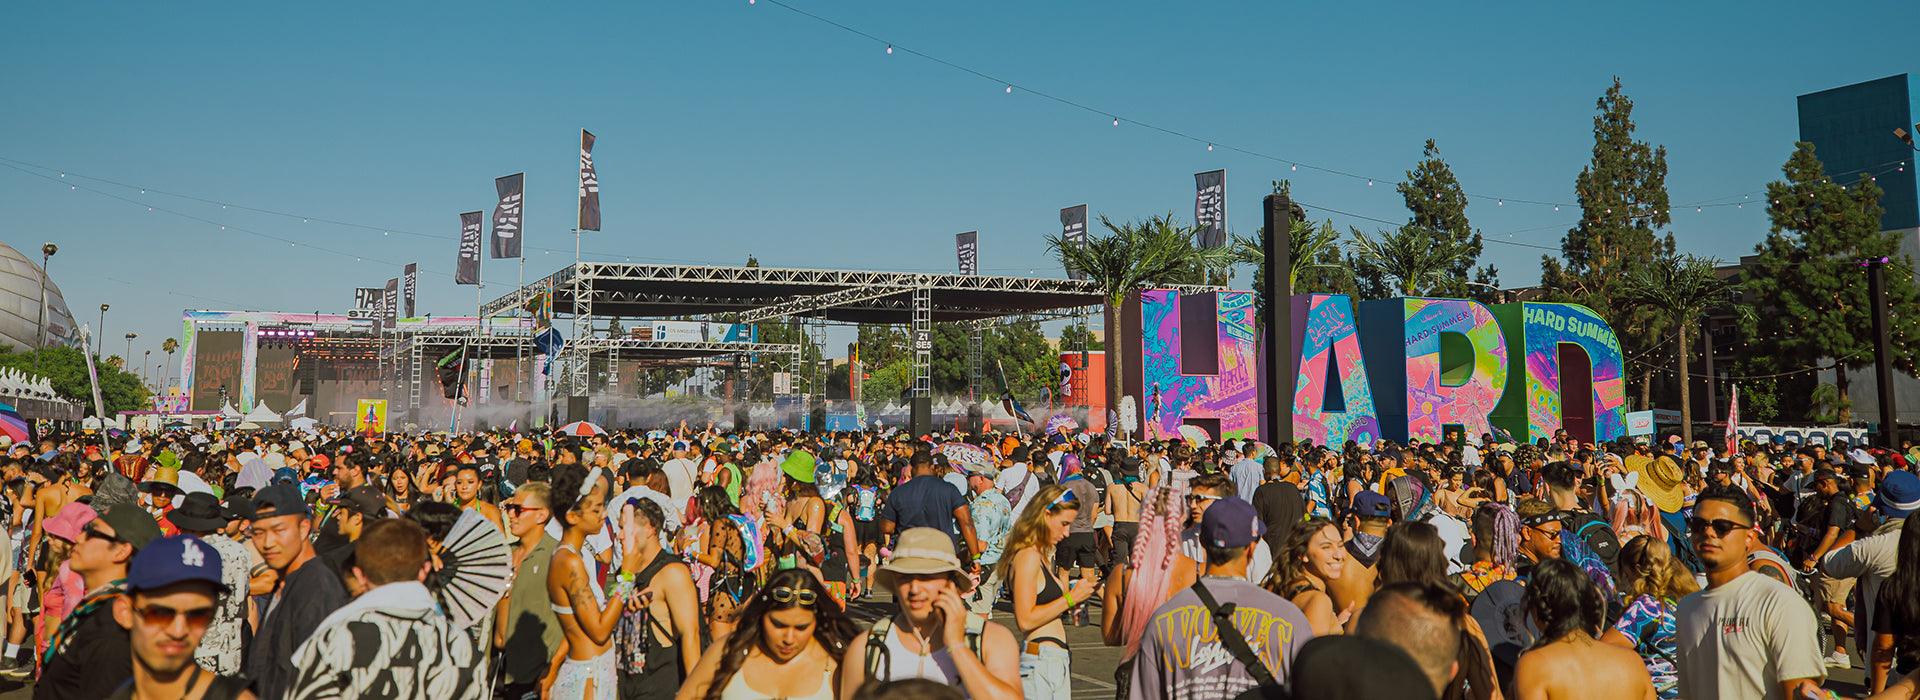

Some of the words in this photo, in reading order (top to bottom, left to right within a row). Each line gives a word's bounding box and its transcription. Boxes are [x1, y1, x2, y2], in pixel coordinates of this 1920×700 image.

[1405, 329, 1431, 347] HARD
[1431, 311, 1470, 335] SUMMER
[1523, 306, 1565, 332] HARD
[1140, 289, 1627, 446] HARD
[1347, 417, 1369, 433] HARD
